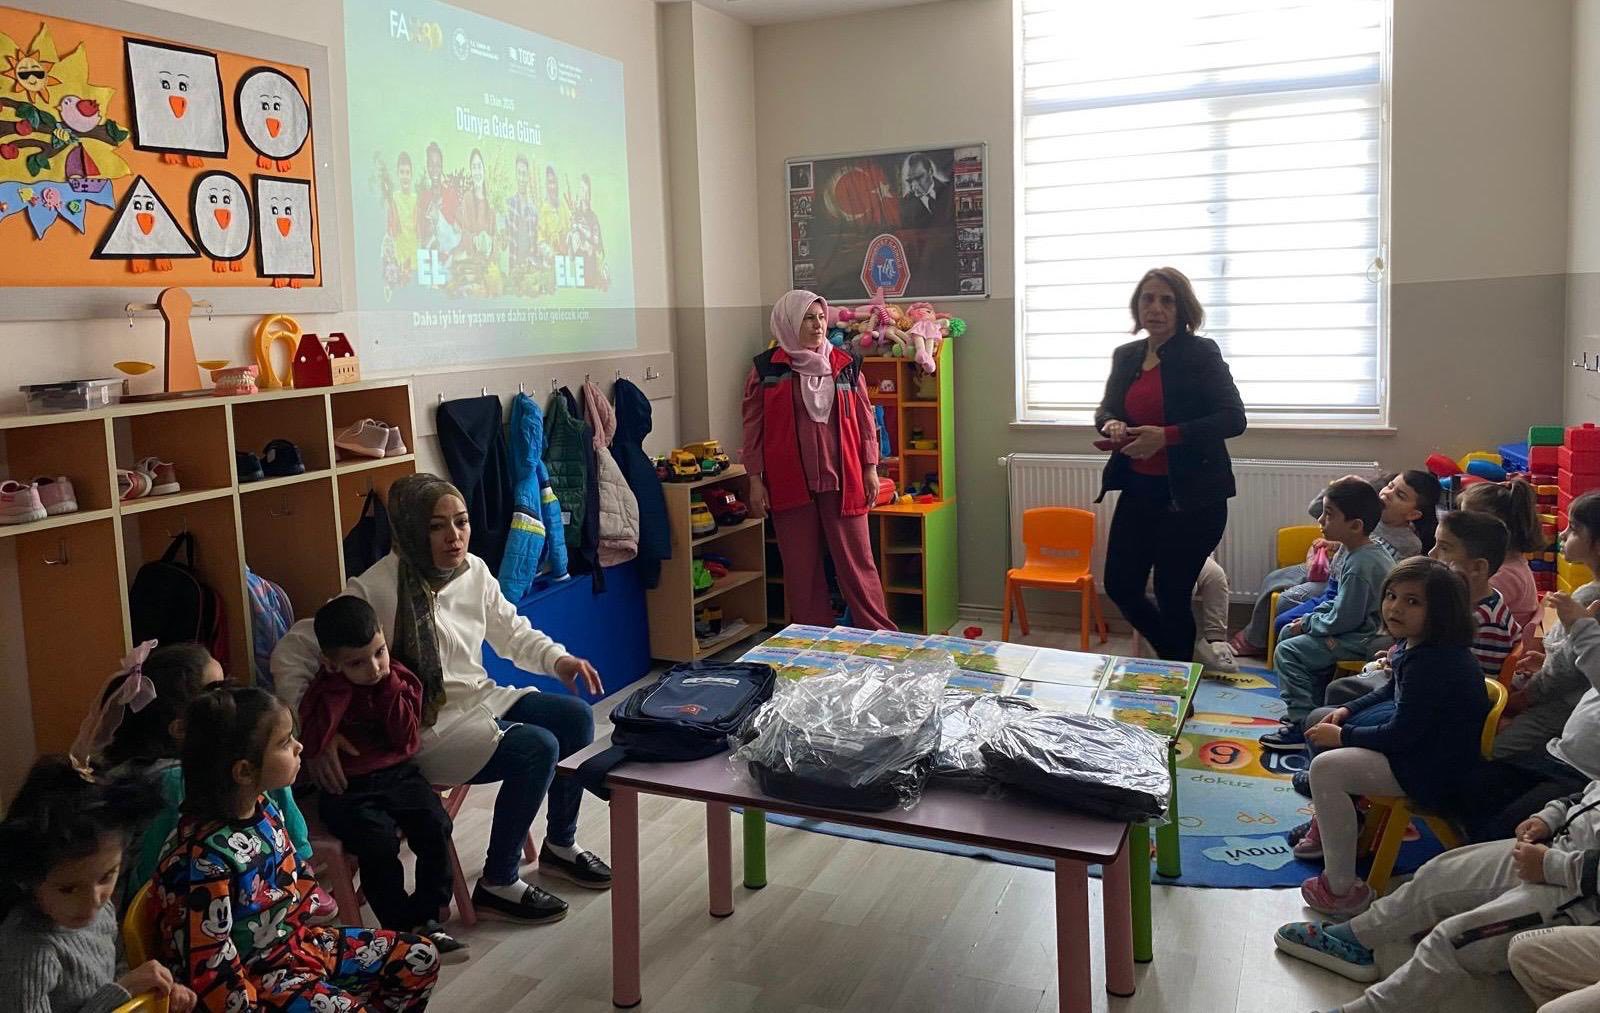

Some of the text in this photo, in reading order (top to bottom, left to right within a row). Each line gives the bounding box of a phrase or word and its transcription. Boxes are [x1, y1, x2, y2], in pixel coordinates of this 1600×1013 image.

[456, 106, 541, 145] Dünya Gıda Günü
[417, 249, 446, 285] EL
[555, 255, 585, 287] ELE
[413, 311, 438, 327] Daha
[440, 309, 451, 328] iyi
[453, 309, 465, 324] bir
[467, 313, 495, 327] yaşam
[496, 312, 506, 323] ve
[507, 308, 527, 322] daha
[1210, 745, 1240, 764] 9
[1191, 774, 1253, 789] dokuz
[1225, 845, 1289, 861] mavi
